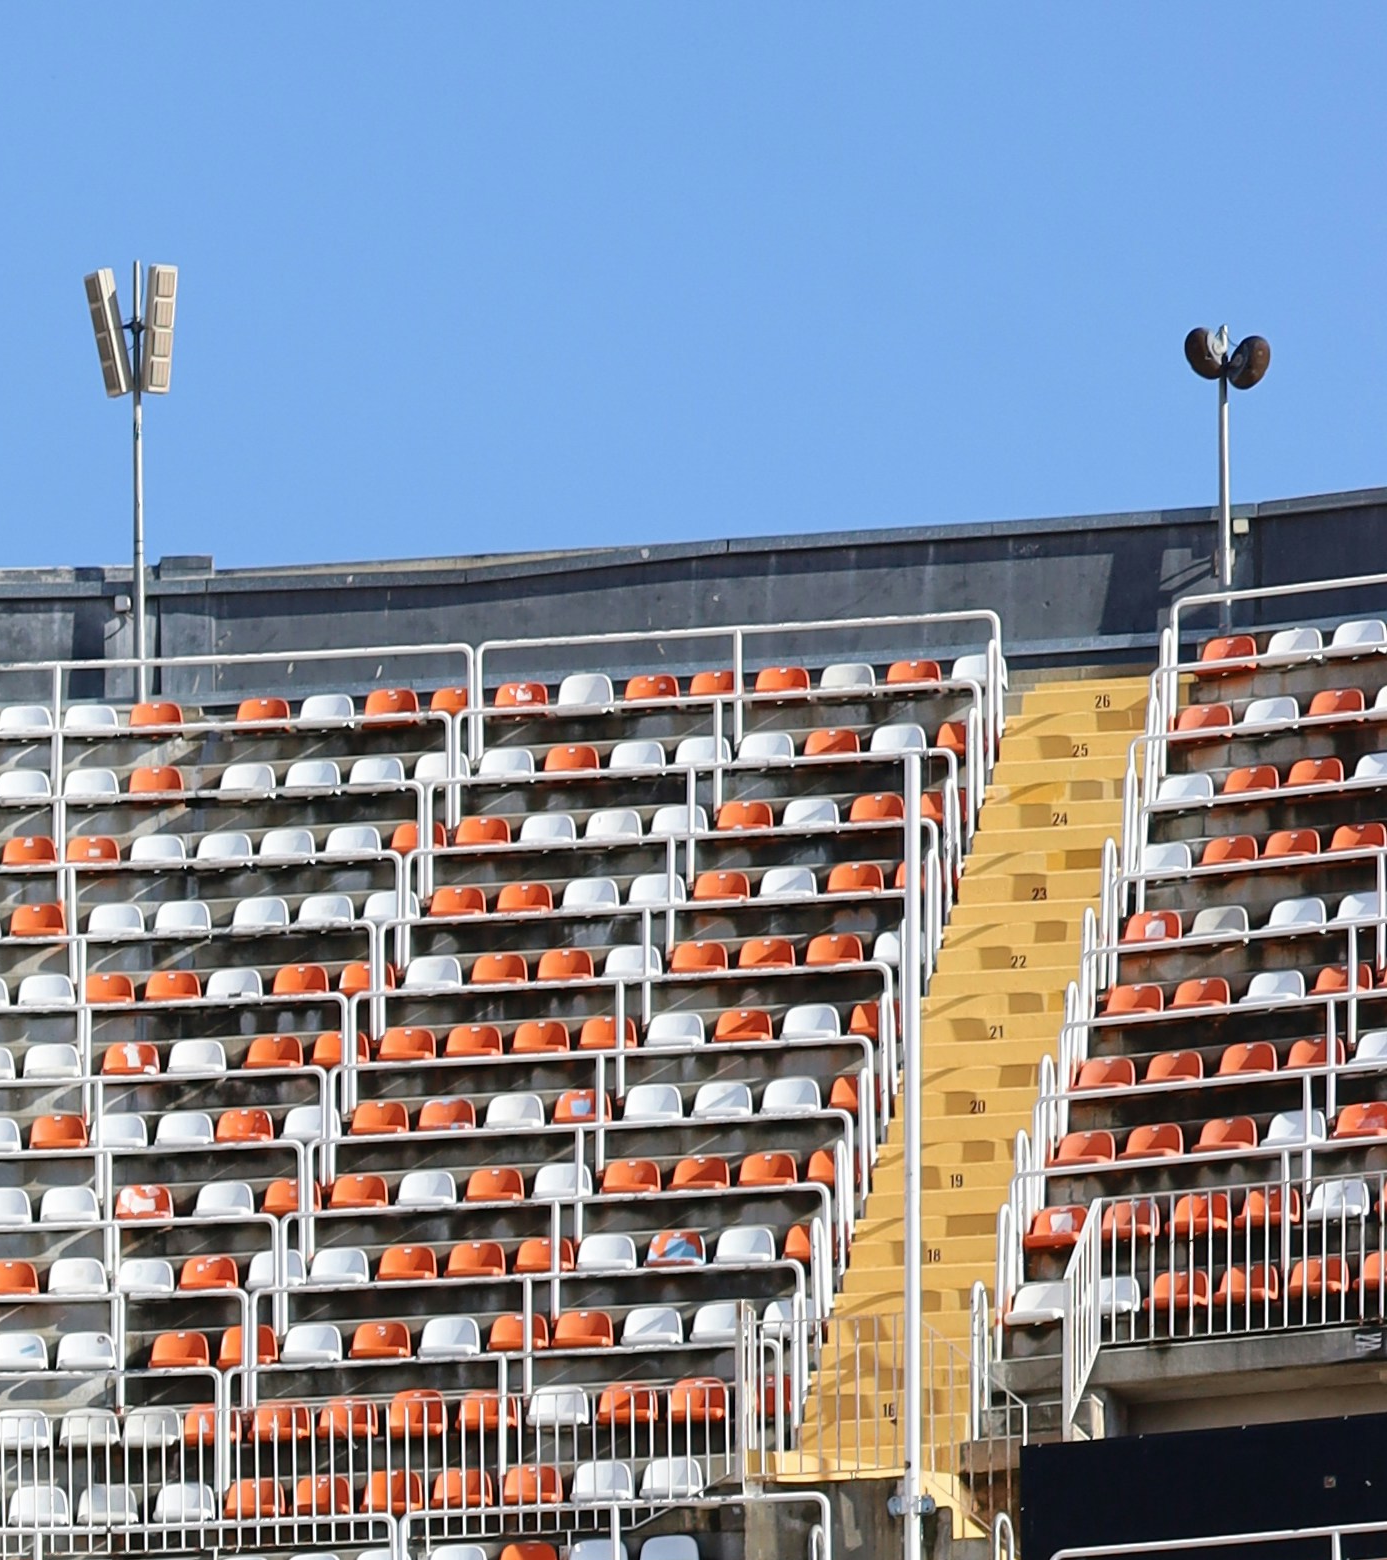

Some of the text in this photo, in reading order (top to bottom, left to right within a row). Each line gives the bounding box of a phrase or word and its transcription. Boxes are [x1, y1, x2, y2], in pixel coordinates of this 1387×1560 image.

[1095, 695, 1111, 708] 26
[1072, 743, 1088, 757] 25
[1052, 812, 1067, 826] 24
[1031, 887, 1047, 901] 23
[1011, 955, 1027, 969] 22
[989, 1025, 1004, 1039] 21
[969, 1100, 986, 1114] 20
[950, 1174, 963, 1188] 19
[927, 1249, 941, 1263] 18
